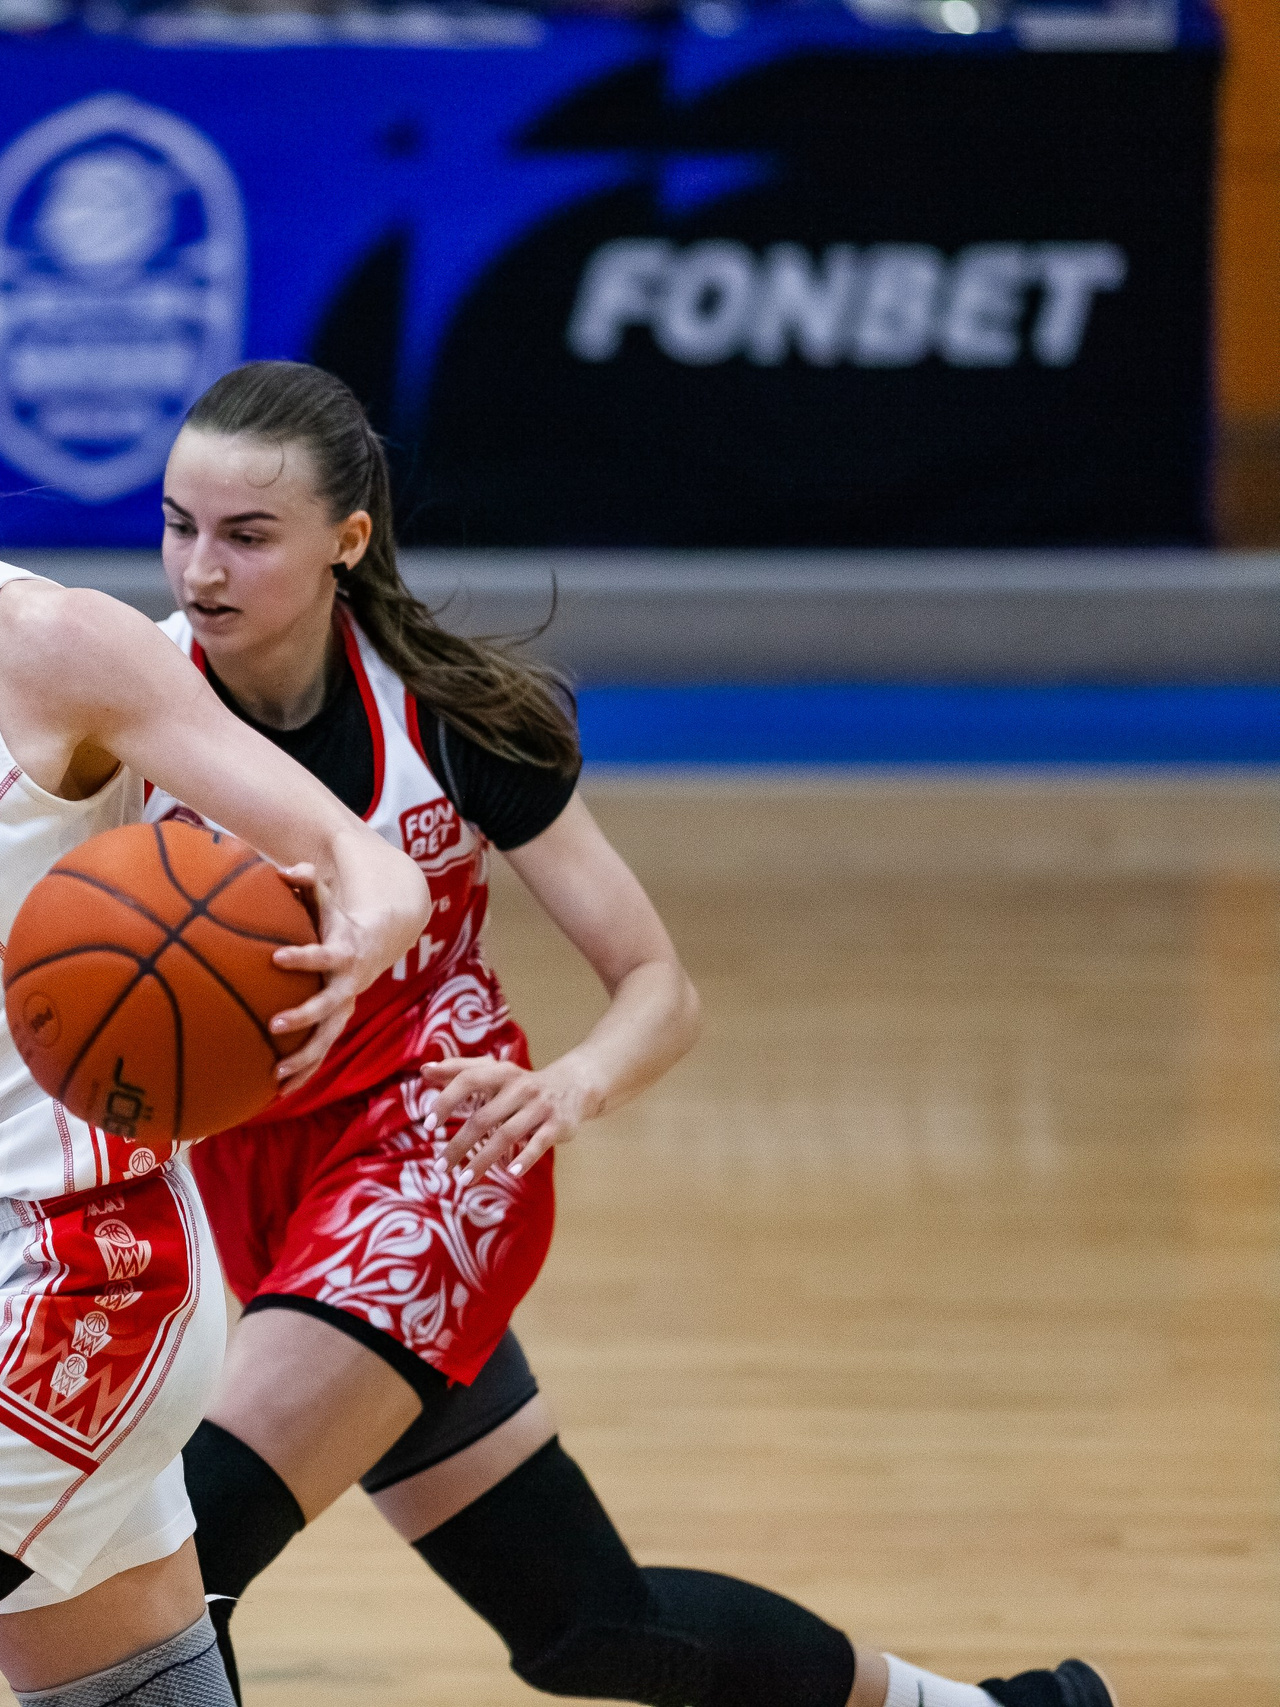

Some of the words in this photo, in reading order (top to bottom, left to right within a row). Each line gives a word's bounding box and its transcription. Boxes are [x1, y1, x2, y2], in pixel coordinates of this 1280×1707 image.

[567, 238, 1125, 367] FONBET
[405, 802, 454, 841] FON
[410, 823, 456, 859] BET
